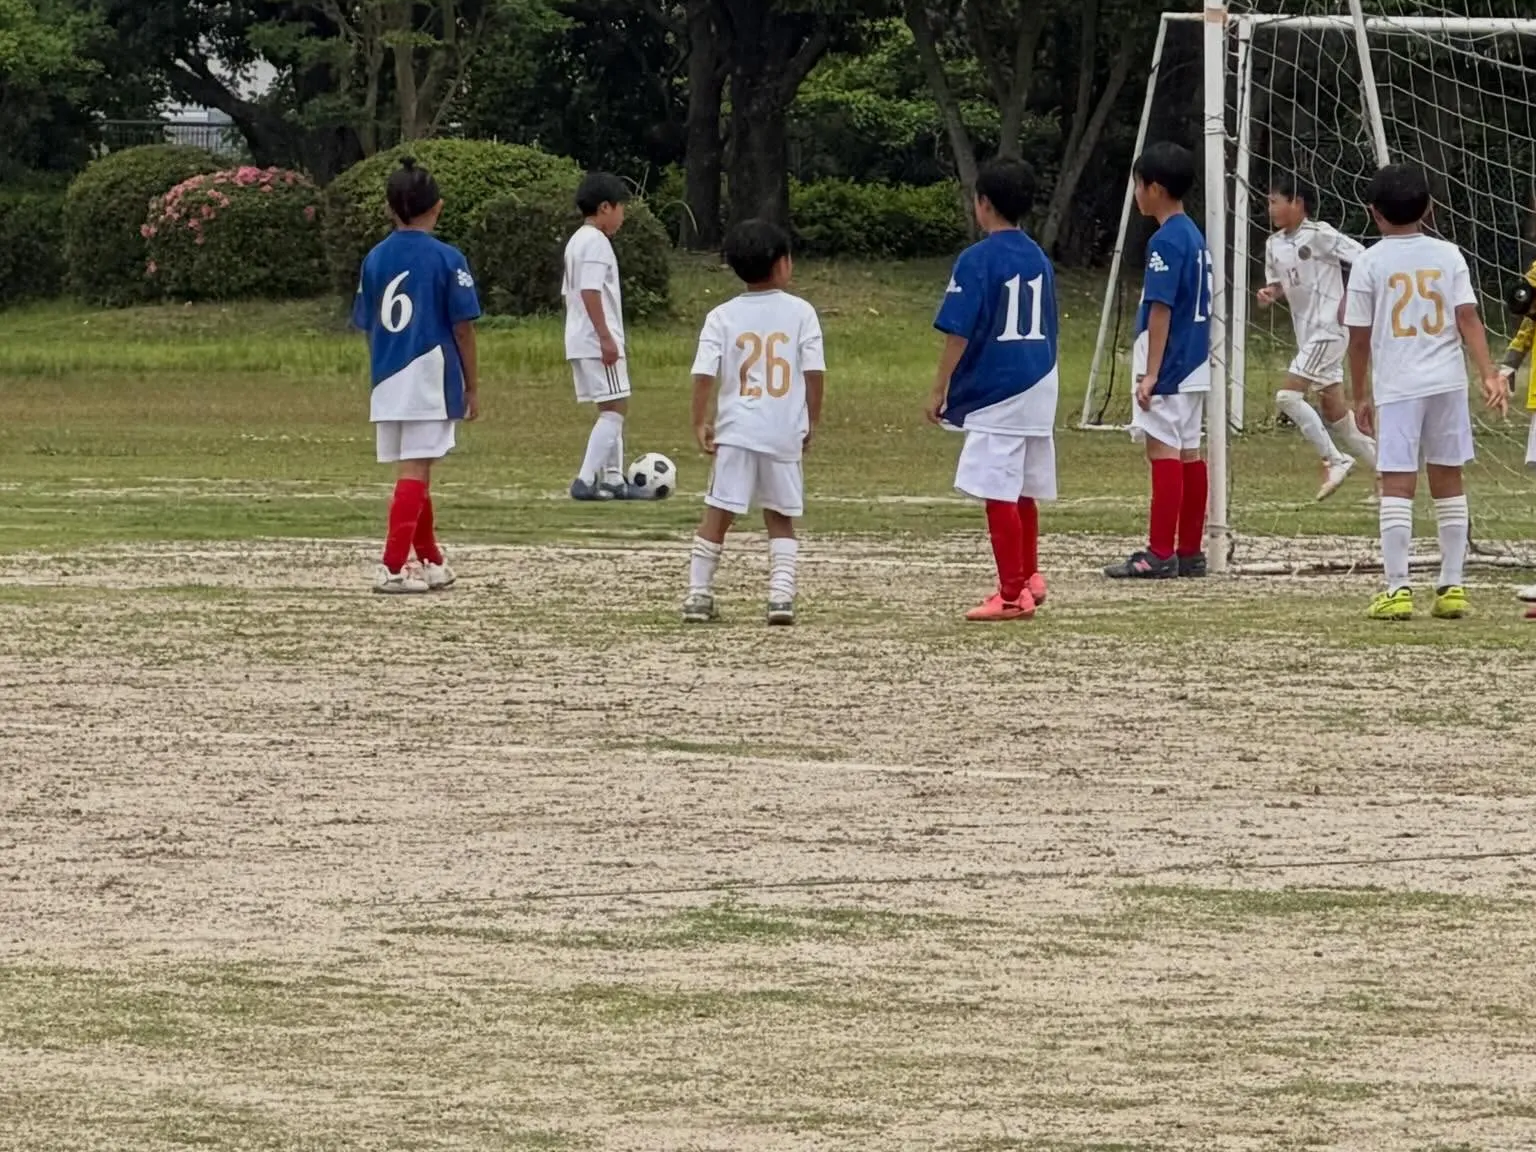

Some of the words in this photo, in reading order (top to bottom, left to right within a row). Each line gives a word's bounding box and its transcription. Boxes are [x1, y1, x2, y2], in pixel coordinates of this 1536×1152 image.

[381, 270, 413, 333] 6
[996, 273, 1046, 341] 11
[1388, 269, 1445, 338] 25
[735, 331, 791, 399] 26
